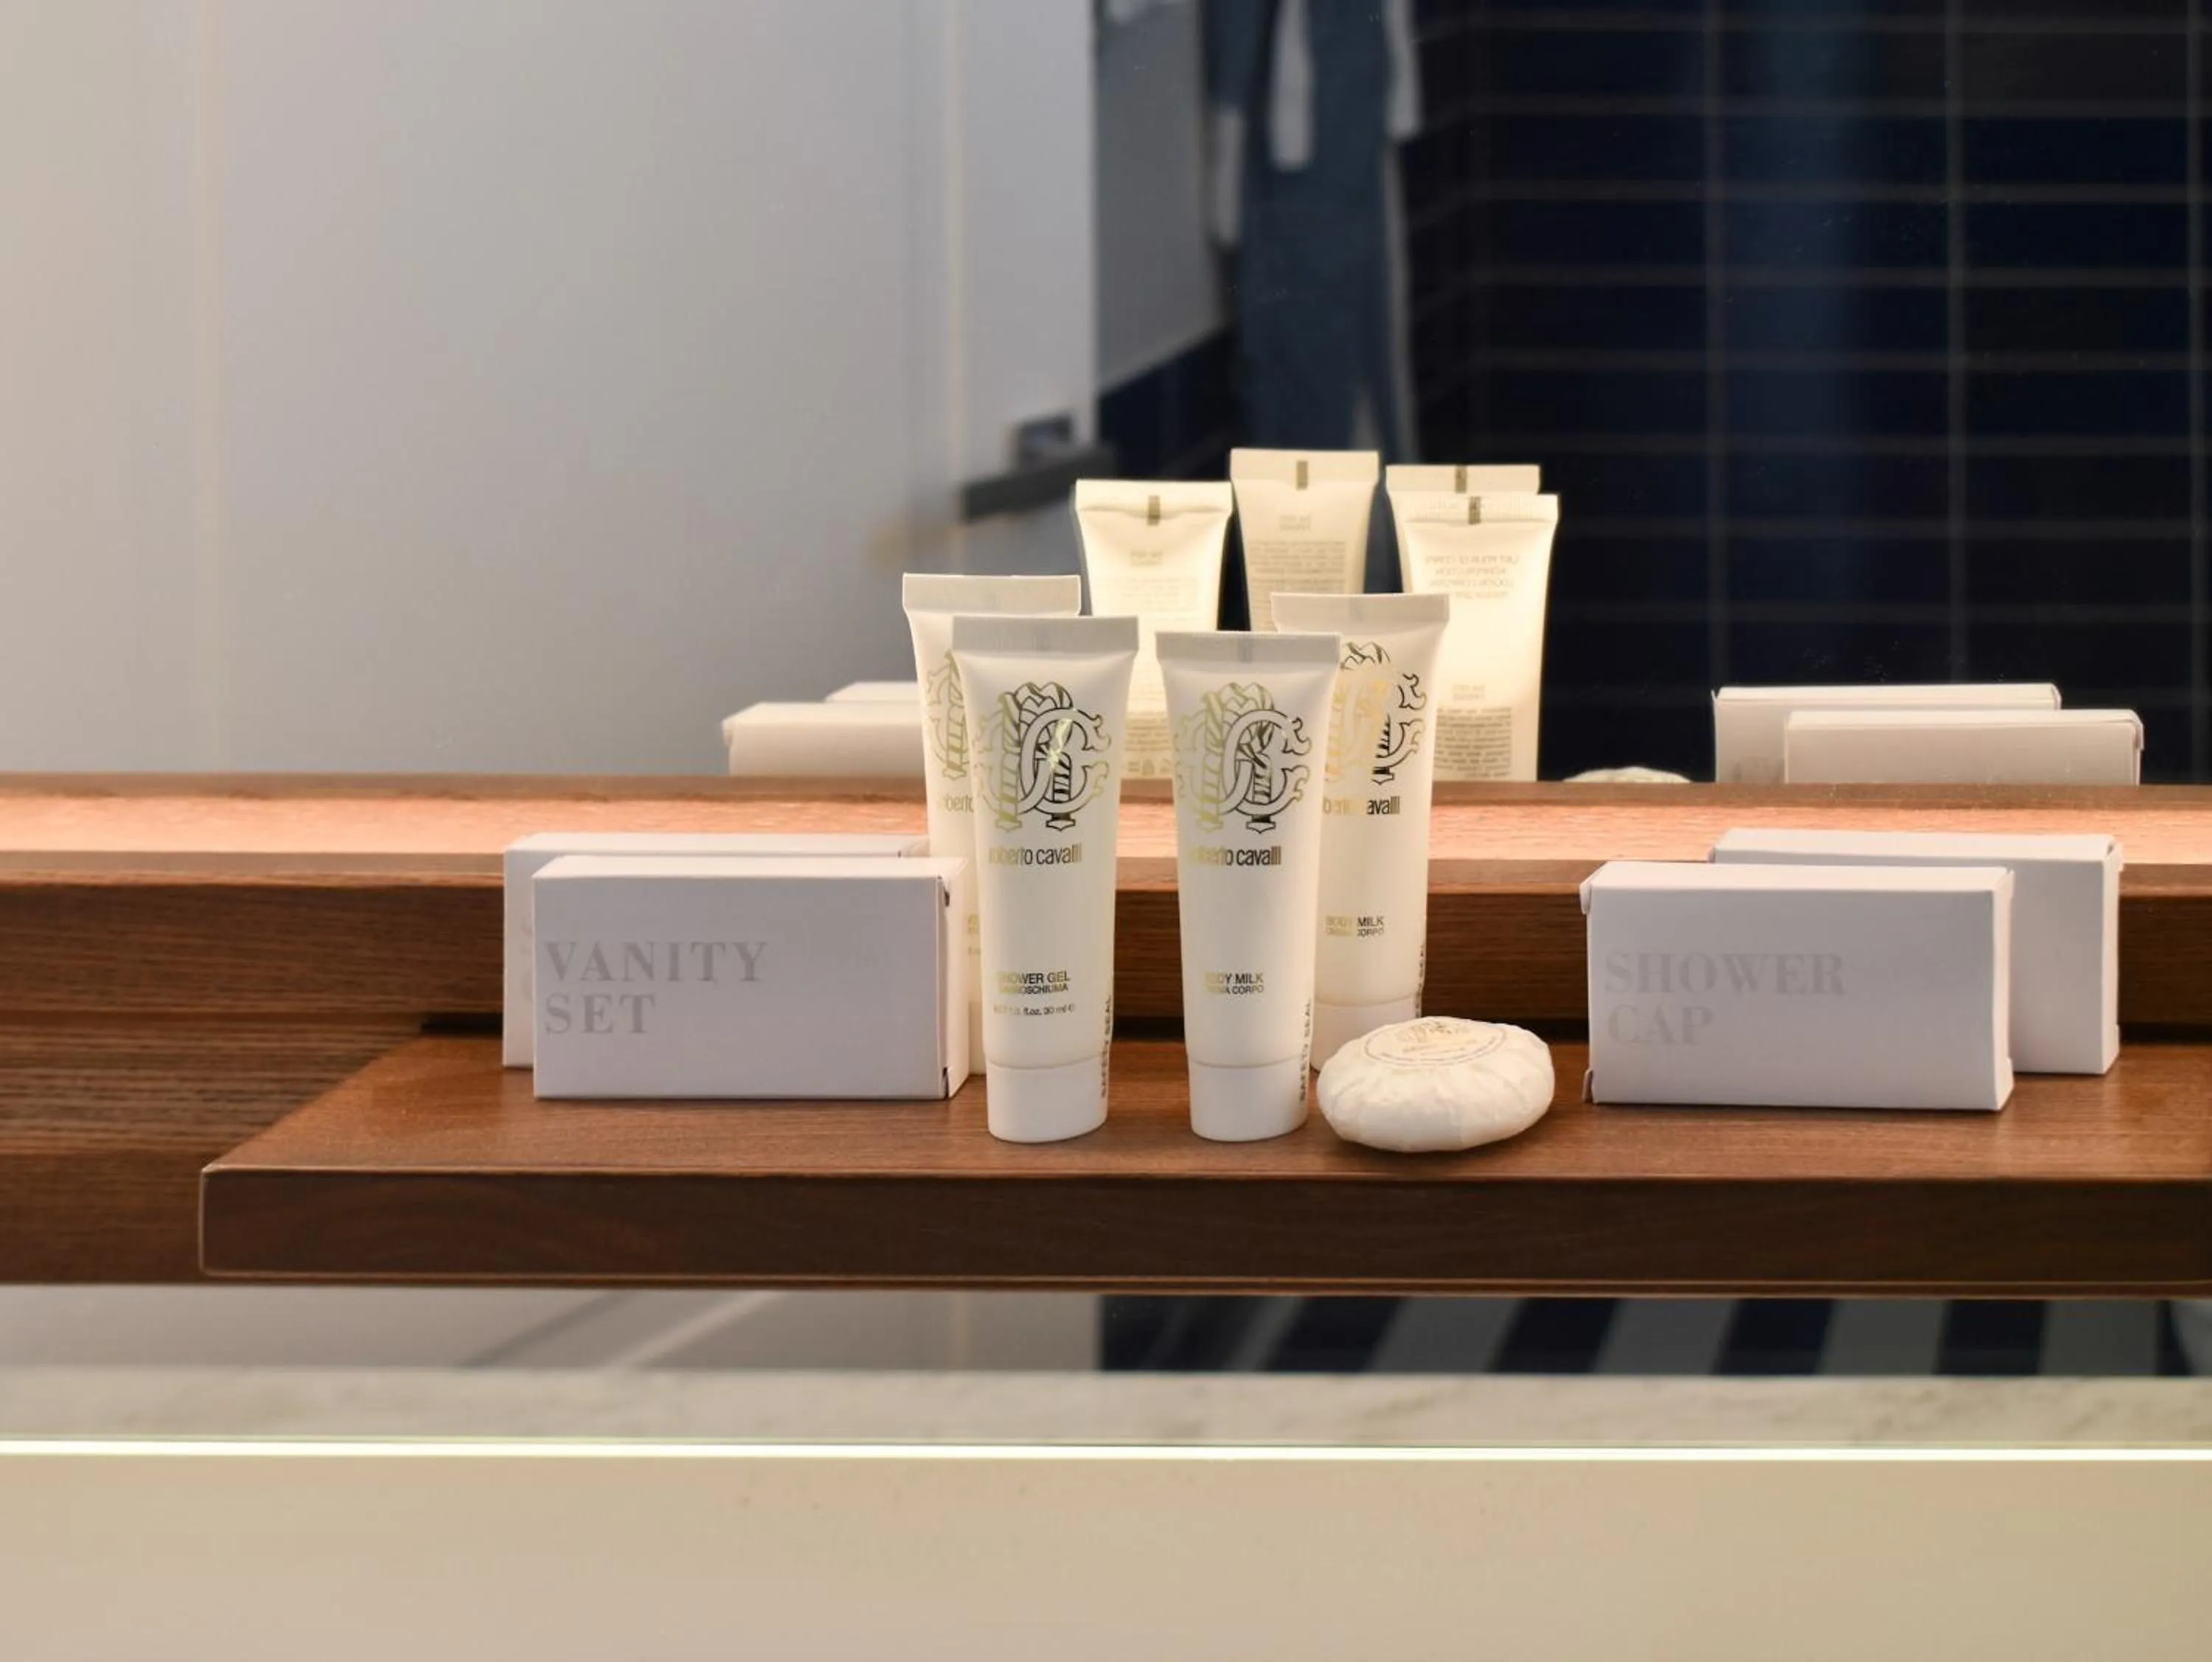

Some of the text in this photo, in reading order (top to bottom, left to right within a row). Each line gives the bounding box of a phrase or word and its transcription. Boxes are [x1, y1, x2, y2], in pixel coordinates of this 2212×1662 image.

[543, 941, 768, 982] VANITY
[1047, 970, 1071, 983] GEL
[1205, 973, 1263, 984] DY MILK
[1604, 951, 1847, 995] SHOWER
[998, 983, 1068, 995] OSCHIUMA
[543, 992, 655, 1034] SET
[1607, 1004, 1714, 1046] CAP
